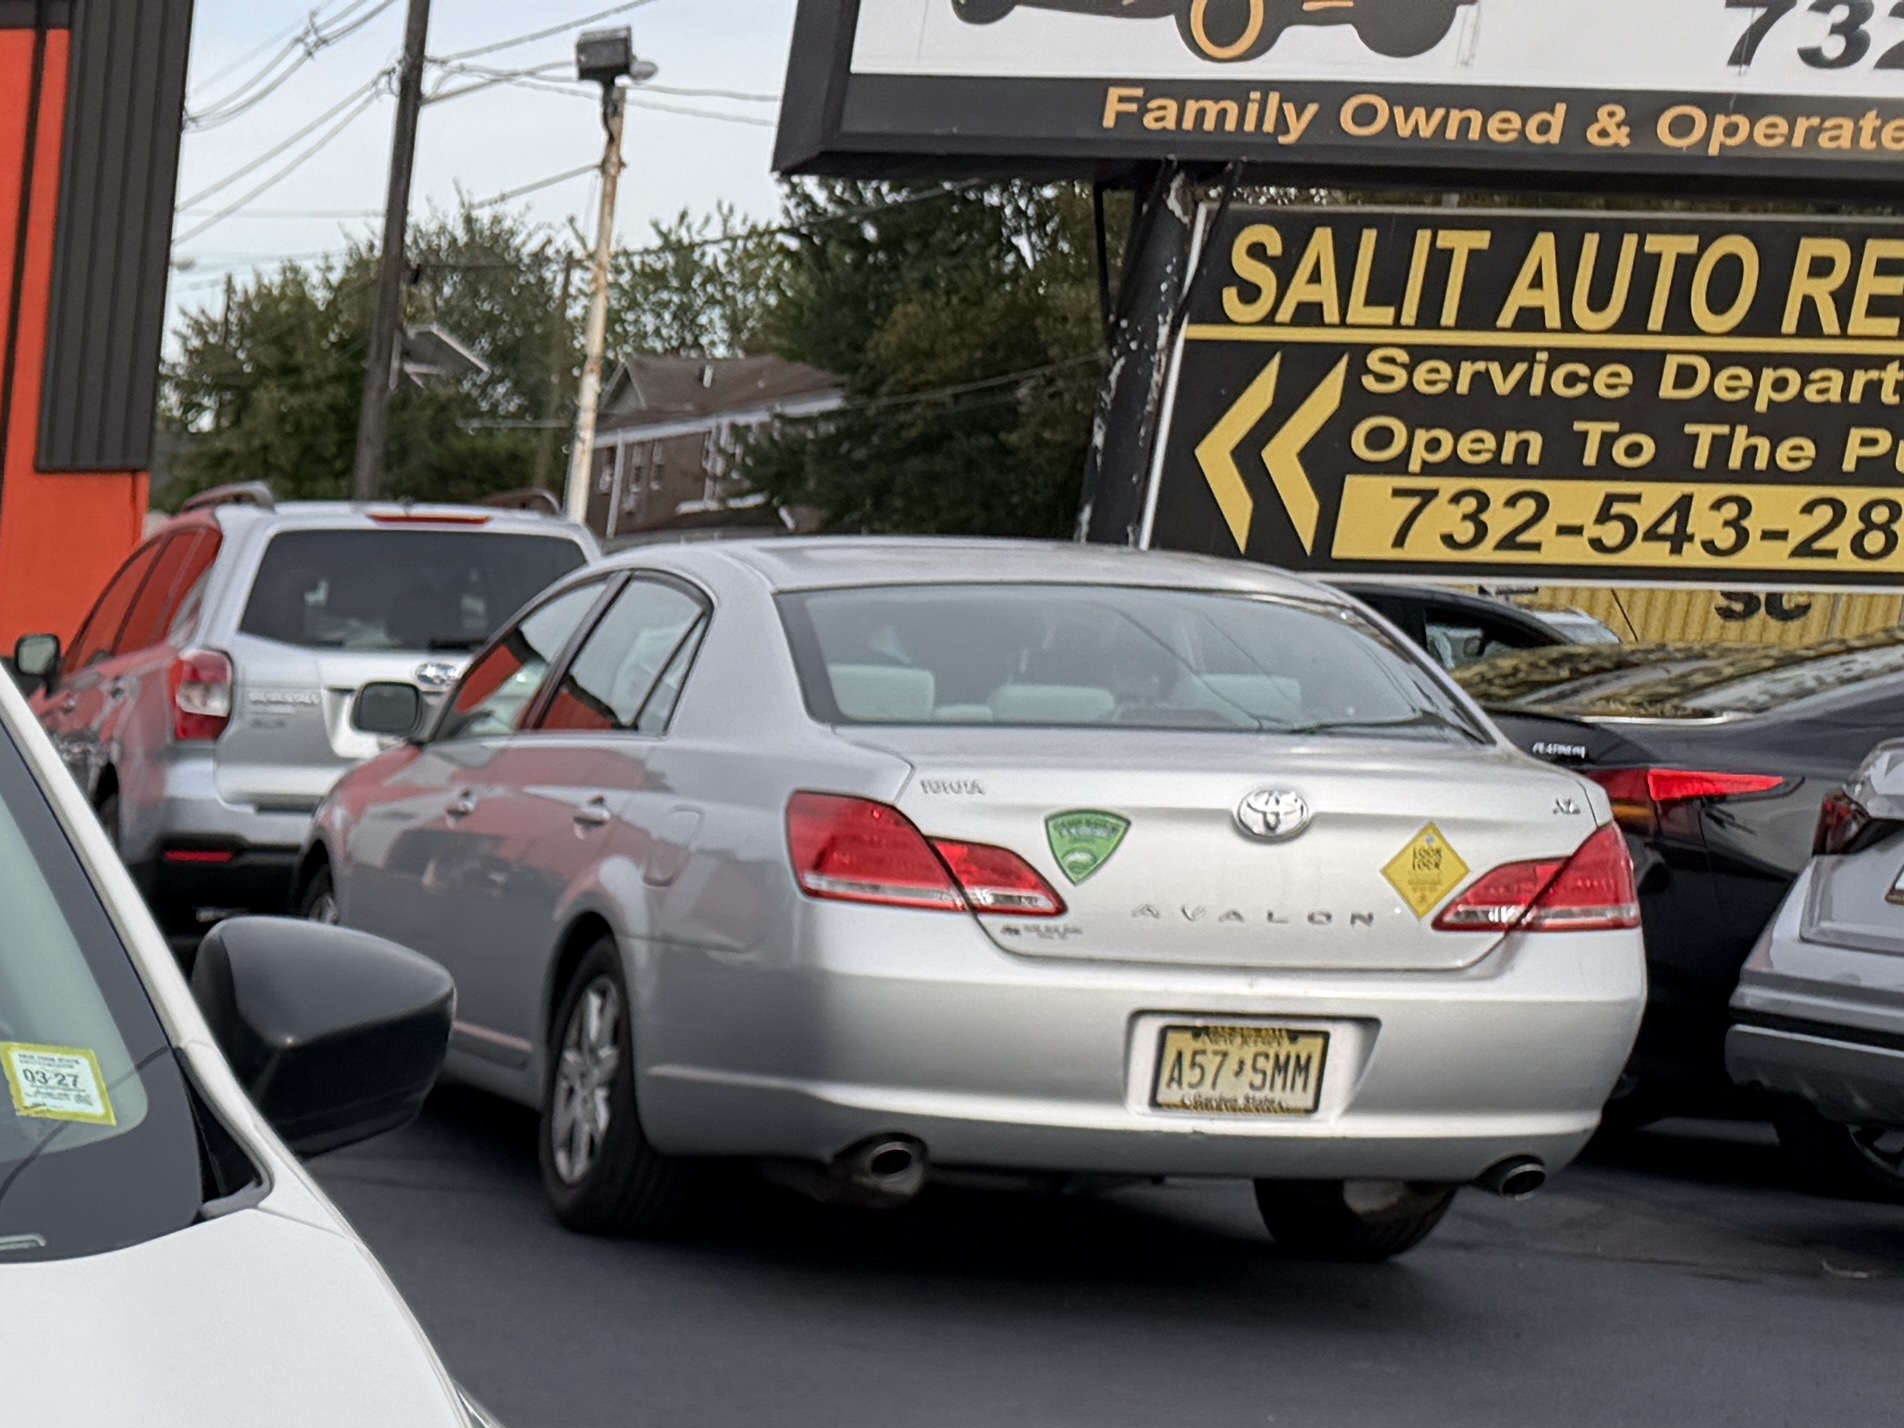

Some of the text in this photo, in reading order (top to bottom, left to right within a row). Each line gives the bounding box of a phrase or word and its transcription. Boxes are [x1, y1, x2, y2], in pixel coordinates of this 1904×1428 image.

[1102, 86, 1320, 145] Family
[1339, 94, 1567, 144] Owned
[1586, 103, 1631, 148] &
[1222, 223, 1492, 328] SALIT
[1495, 231, 1760, 334] AUTO
[1361, 346, 1634, 399] Service
[1350, 415, 1543, 473] Open
[1573, 420, 1656, 469] To
[1683, 423, 1817, 472] The
[1390, 485, 1903, 561] 732-543-28
[1131, 903, 1375, 927] AVALON
[1165, 1049, 1312, 1094] A57 SMM
